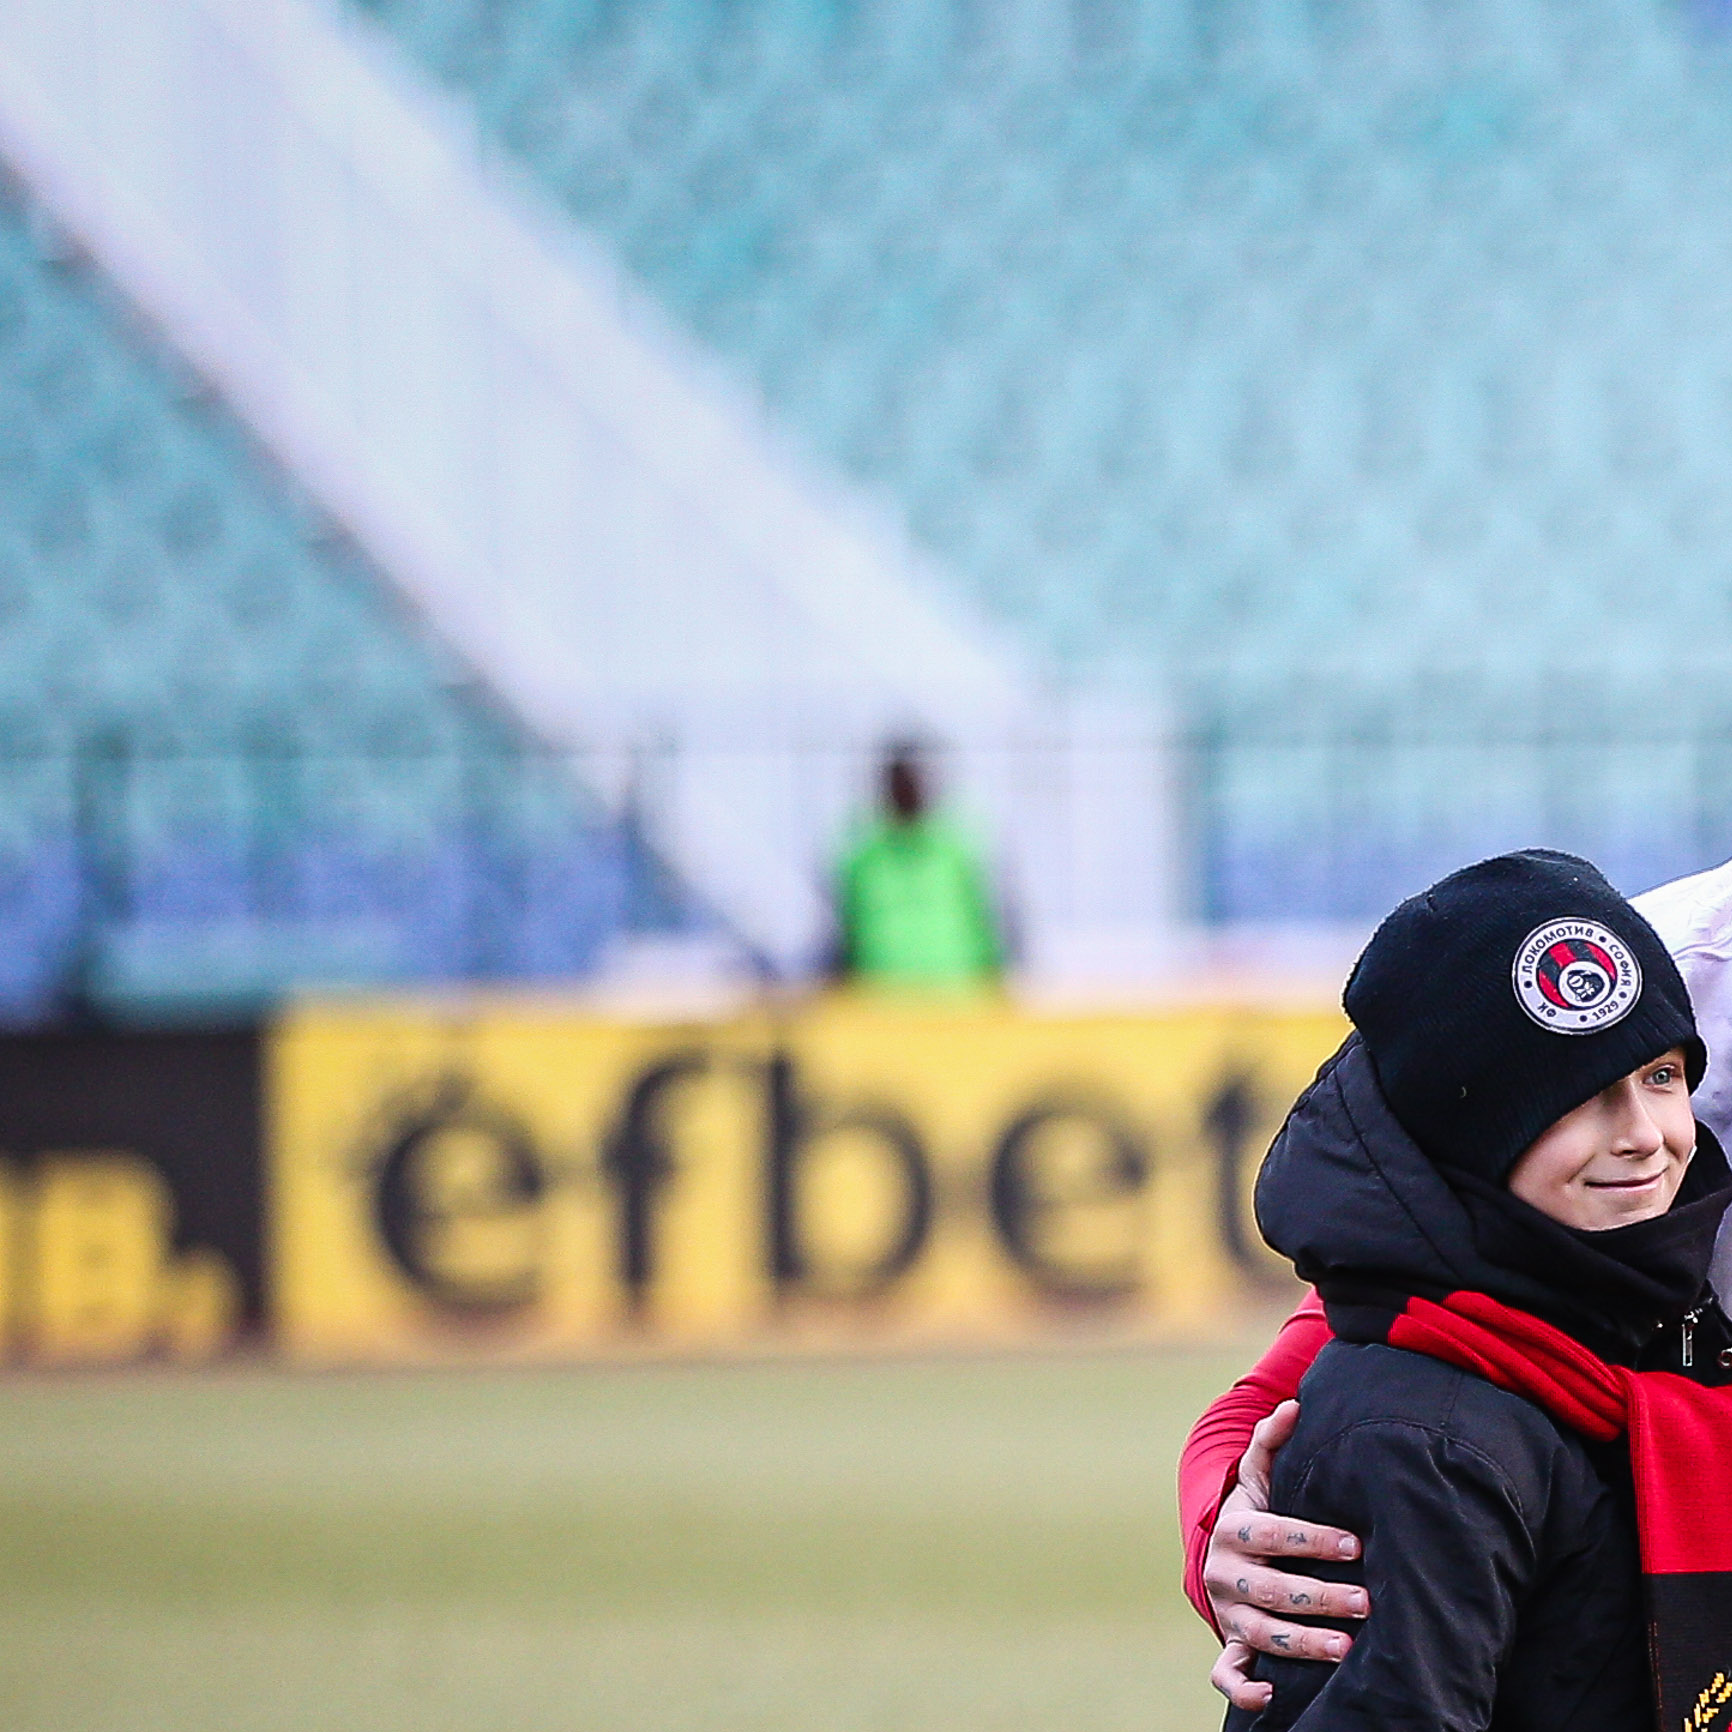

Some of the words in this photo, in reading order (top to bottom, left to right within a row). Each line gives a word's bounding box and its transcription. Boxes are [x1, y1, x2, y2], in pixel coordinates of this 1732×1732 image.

[1522, 925, 1594, 974] ЛОКОМОТИВ
[1609, 944, 1632, 987] СОФИЯ
[1537, 1002, 1557, 1018] ФК
[1592, 1000, 1619, 1021] 1929
